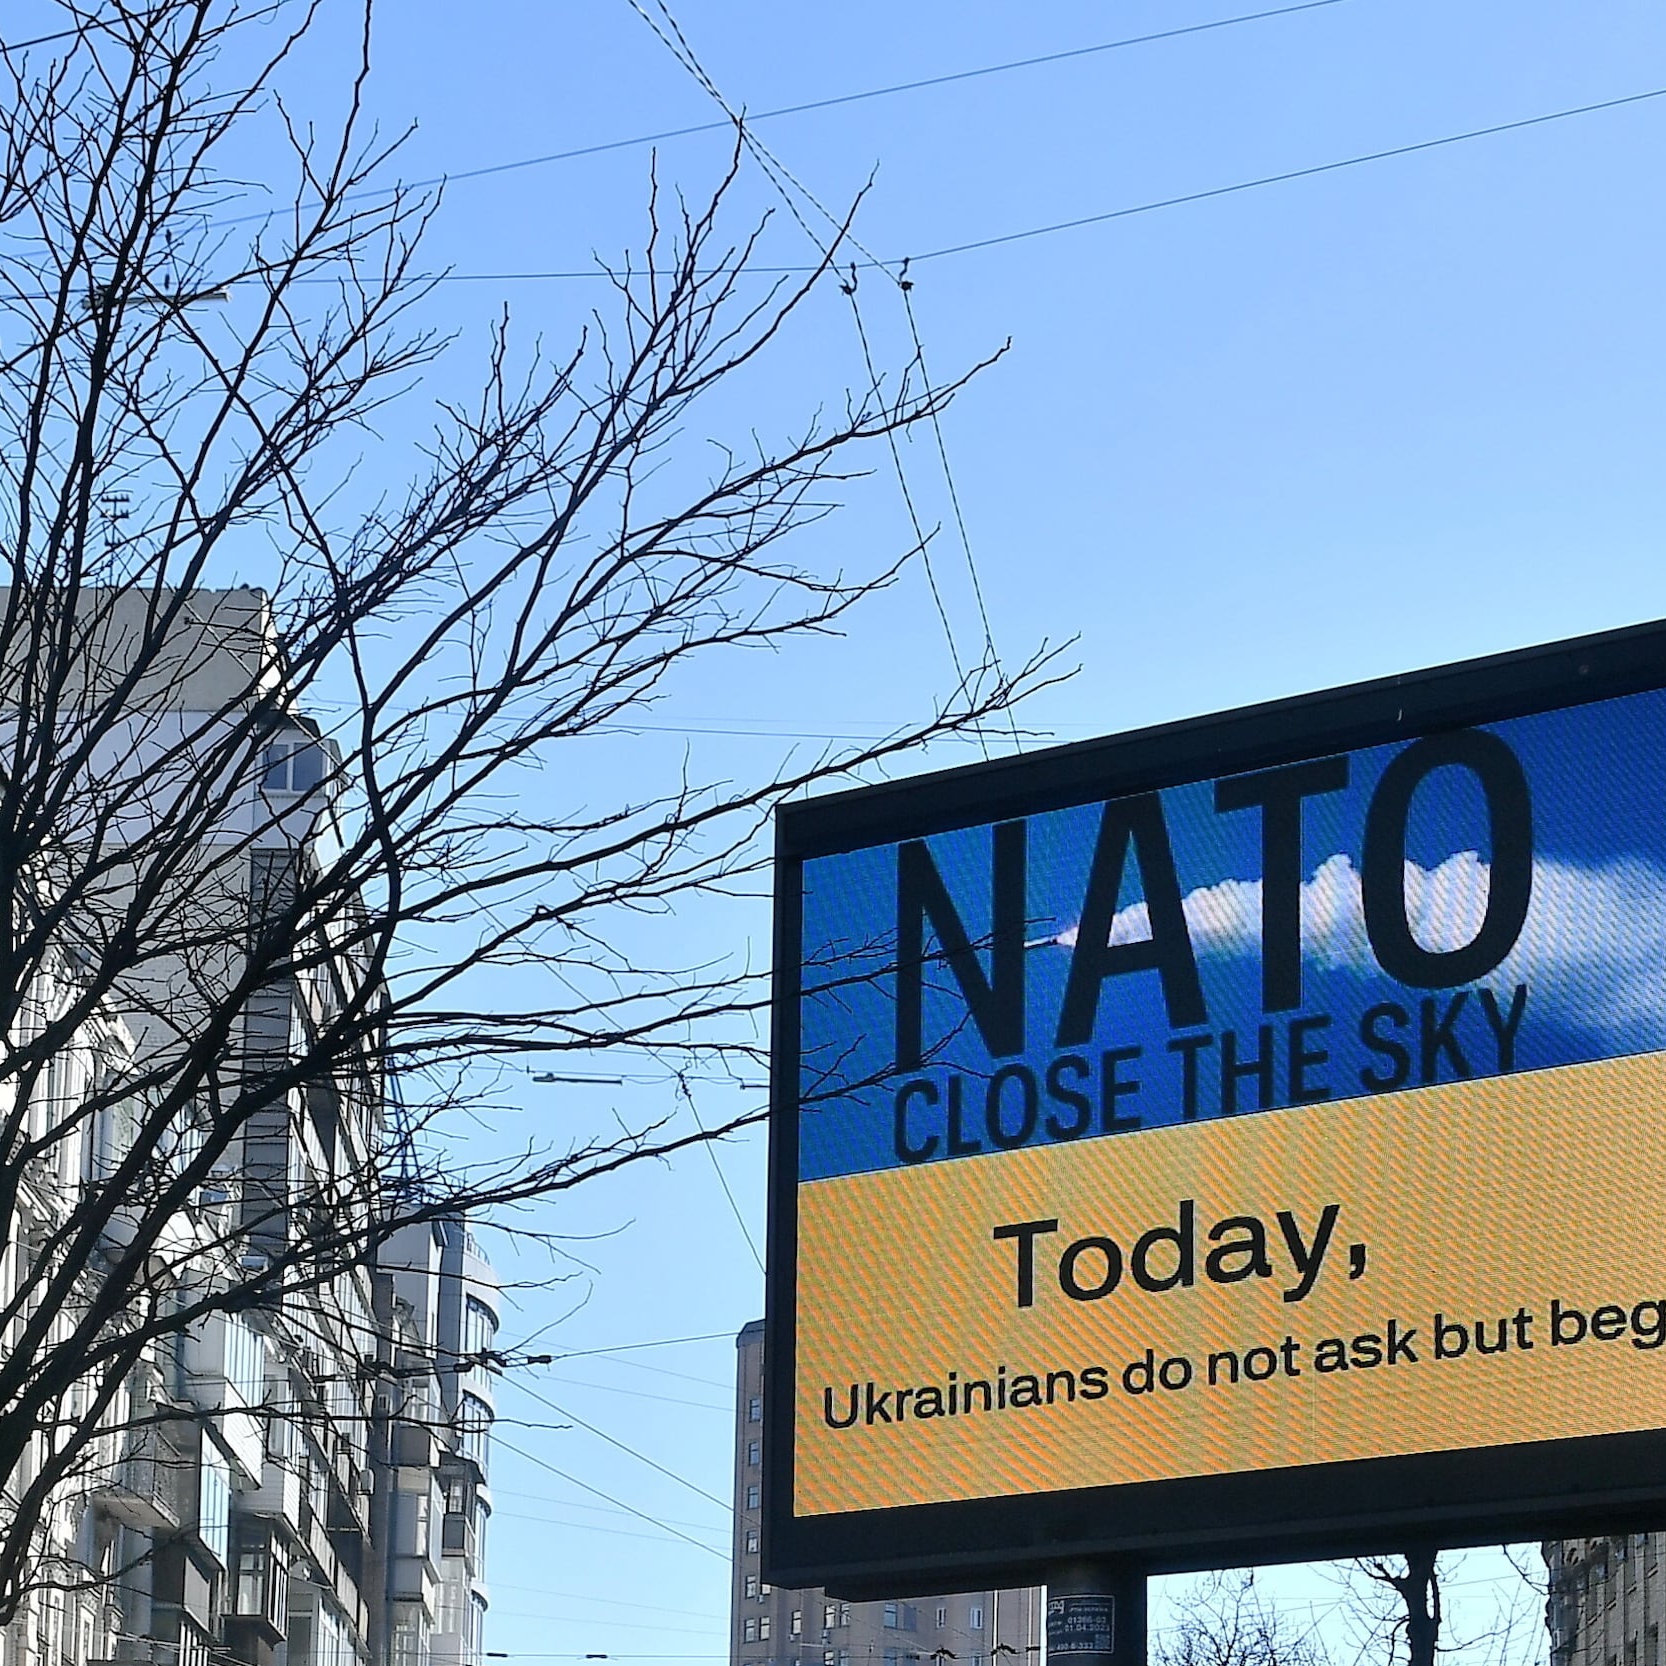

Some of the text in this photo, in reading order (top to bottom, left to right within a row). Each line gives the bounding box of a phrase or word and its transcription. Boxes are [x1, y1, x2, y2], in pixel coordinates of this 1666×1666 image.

[896, 727, 1534, 1075] NATO
[894, 984, 1528, 1165] CLOSE THE SKY
[992, 1199, 1367, 1309] Today,
[823, 1365, 1109, 1430] Ukrainians
[1122, 1347, 1193, 1396] do
[1207, 1335, 1301, 1386] not
[1313, 1318, 1419, 1375] ask
[1434, 1306, 1535, 1360] but
